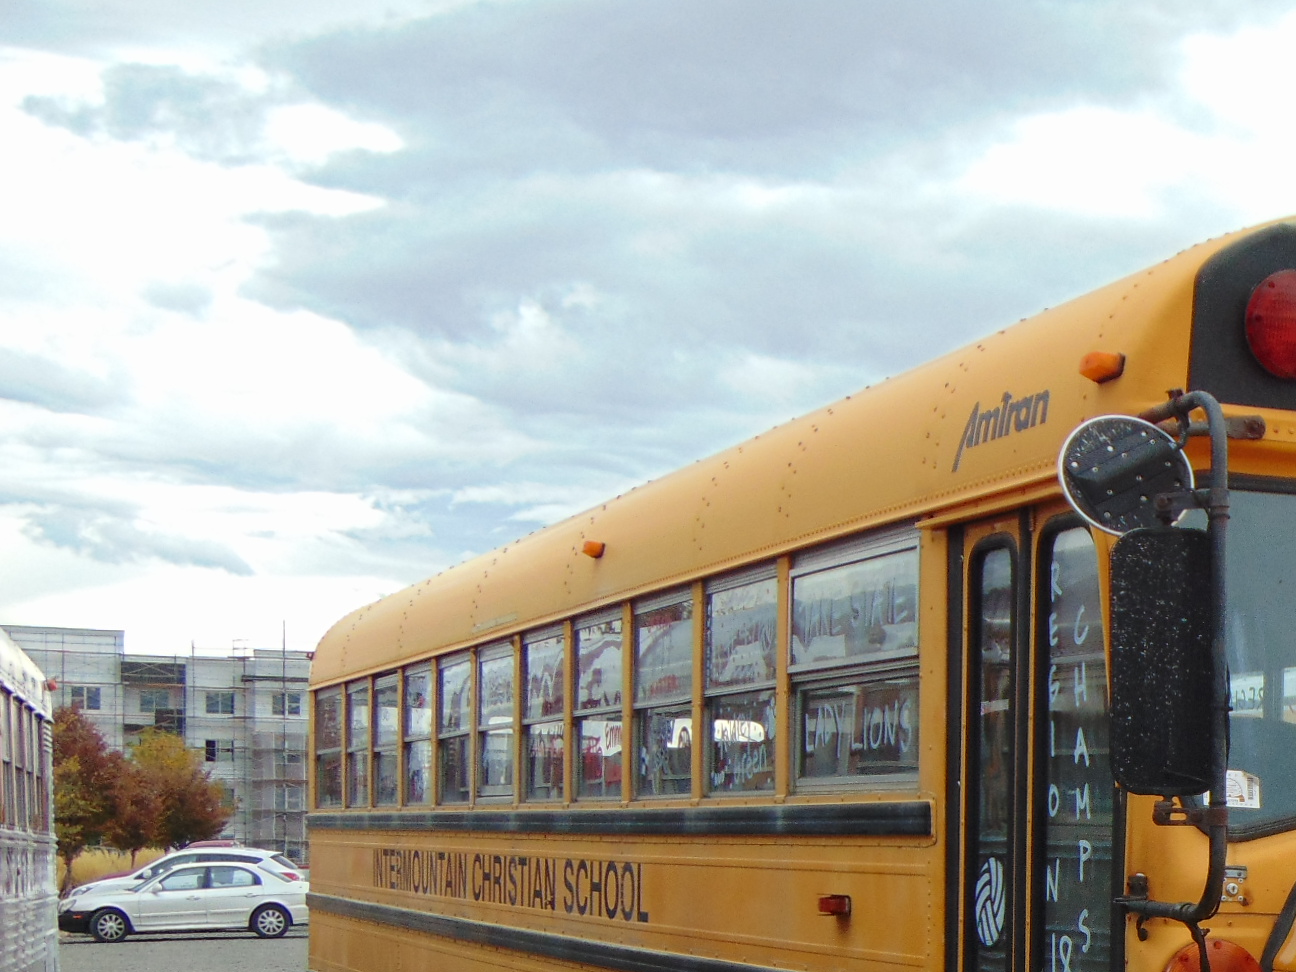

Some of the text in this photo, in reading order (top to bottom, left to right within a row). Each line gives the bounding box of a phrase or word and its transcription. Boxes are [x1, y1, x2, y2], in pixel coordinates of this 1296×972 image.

[951, 389, 1050, 473] Amtran
[805, 701, 846, 759] LADY
[852, 698, 913, 752] LIONS
[373, 848, 648, 922] INTERMOUNTAIN CHRISTIAN SCHOOL
